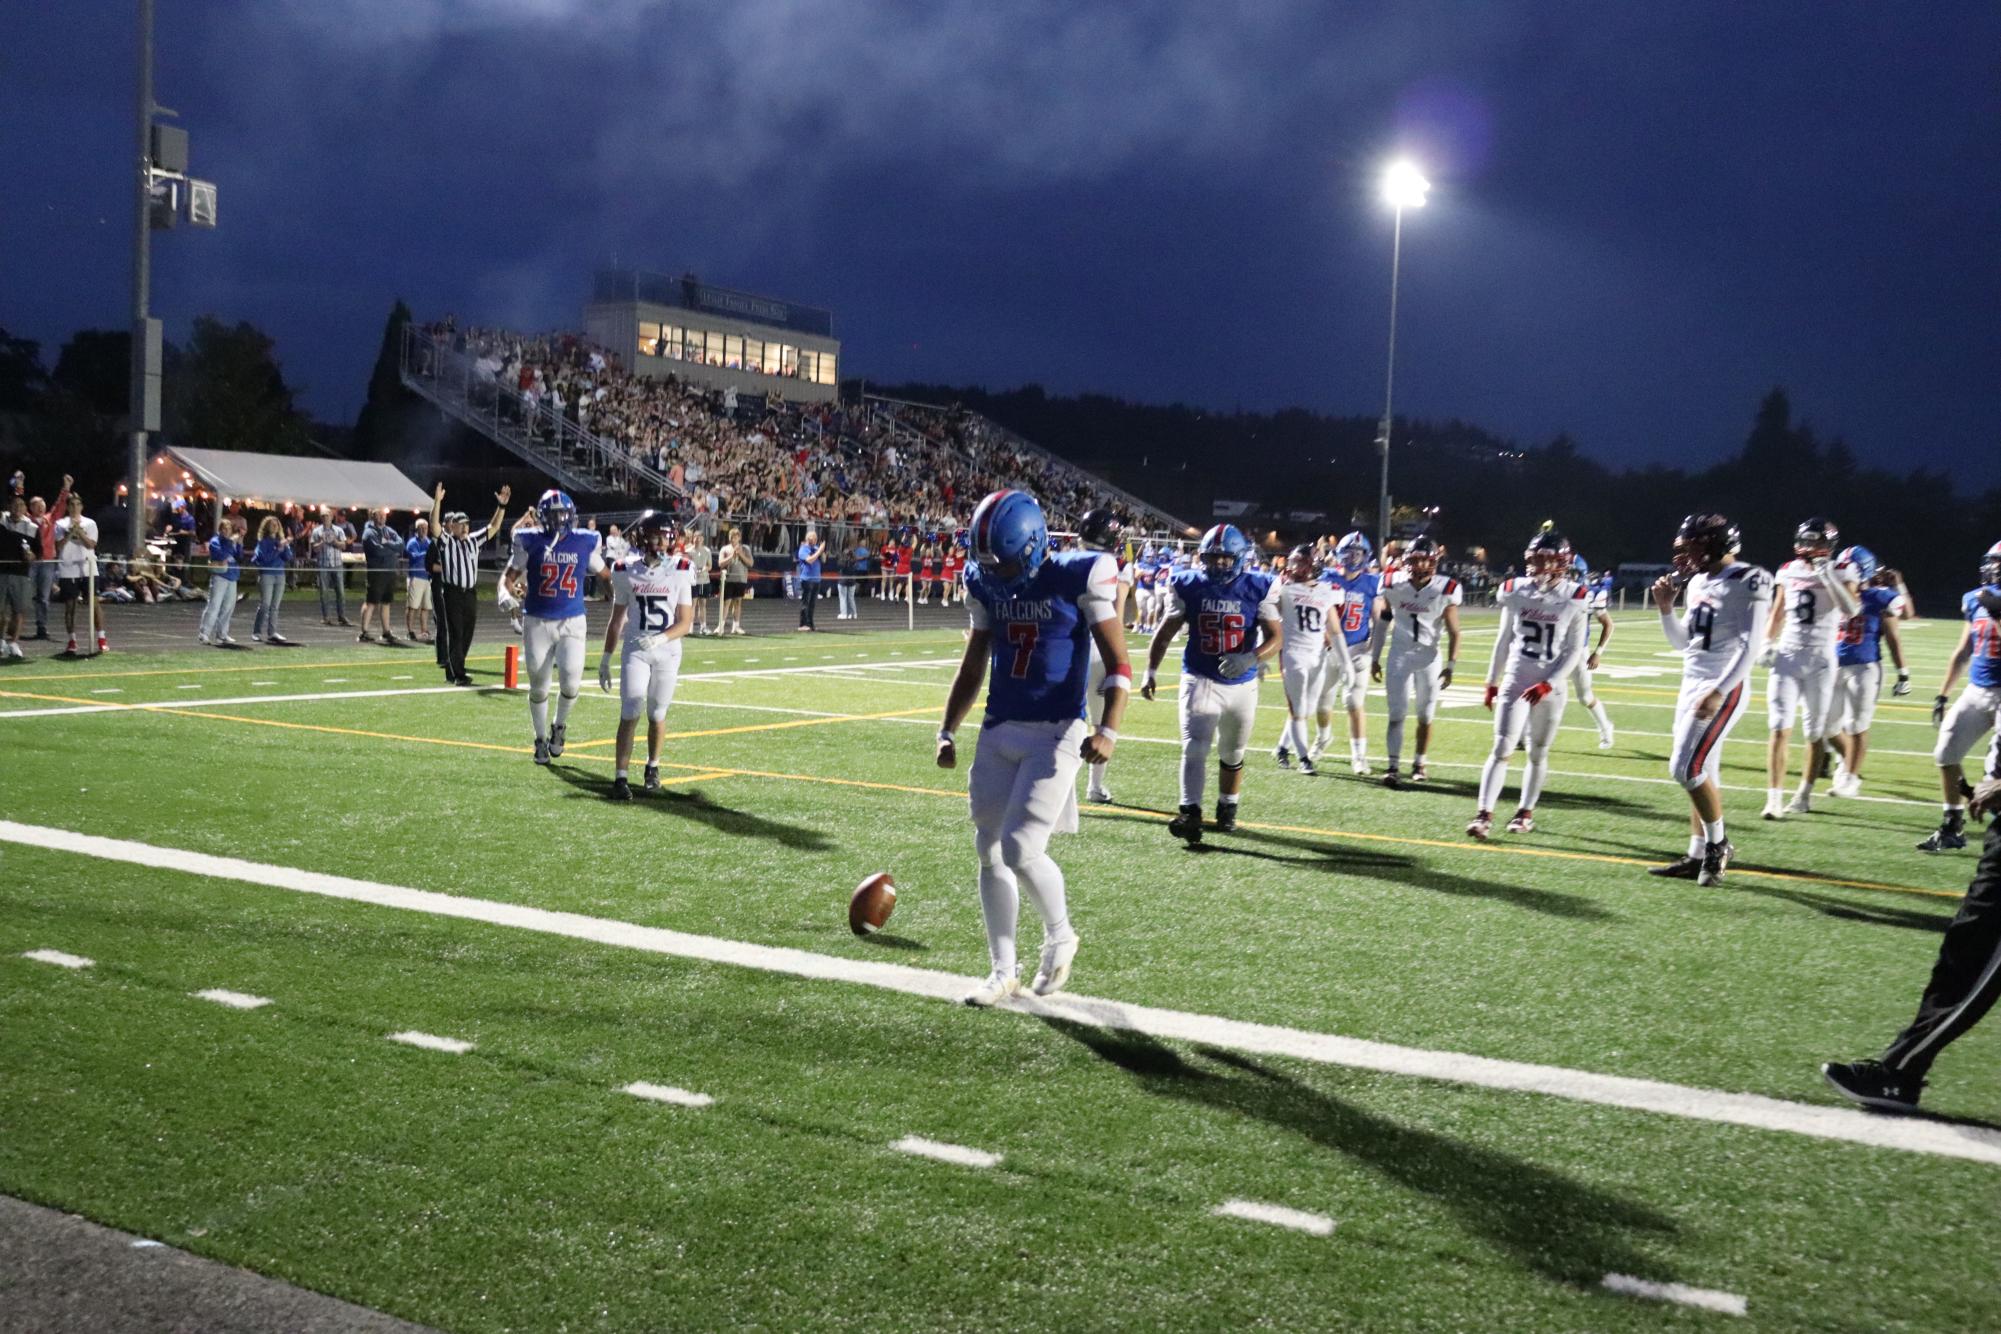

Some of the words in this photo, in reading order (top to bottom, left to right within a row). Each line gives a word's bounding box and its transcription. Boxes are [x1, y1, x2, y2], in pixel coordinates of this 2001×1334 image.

[540, 563, 578, 599] 24
[633, 583, 671, 593] Wildcats
[636, 595, 669, 634] 15
[995, 599, 1053, 620] FALCONS
[1201, 598, 1242, 614] FALCONS
[1295, 605, 1321, 632] 10
[1795, 589, 1816, 624] 8
[1198, 613, 1246, 655] 56
[1409, 612, 1420, 642] 1
[1521, 620, 1556, 660] 21
[1007, 622, 1040, 679] 7
